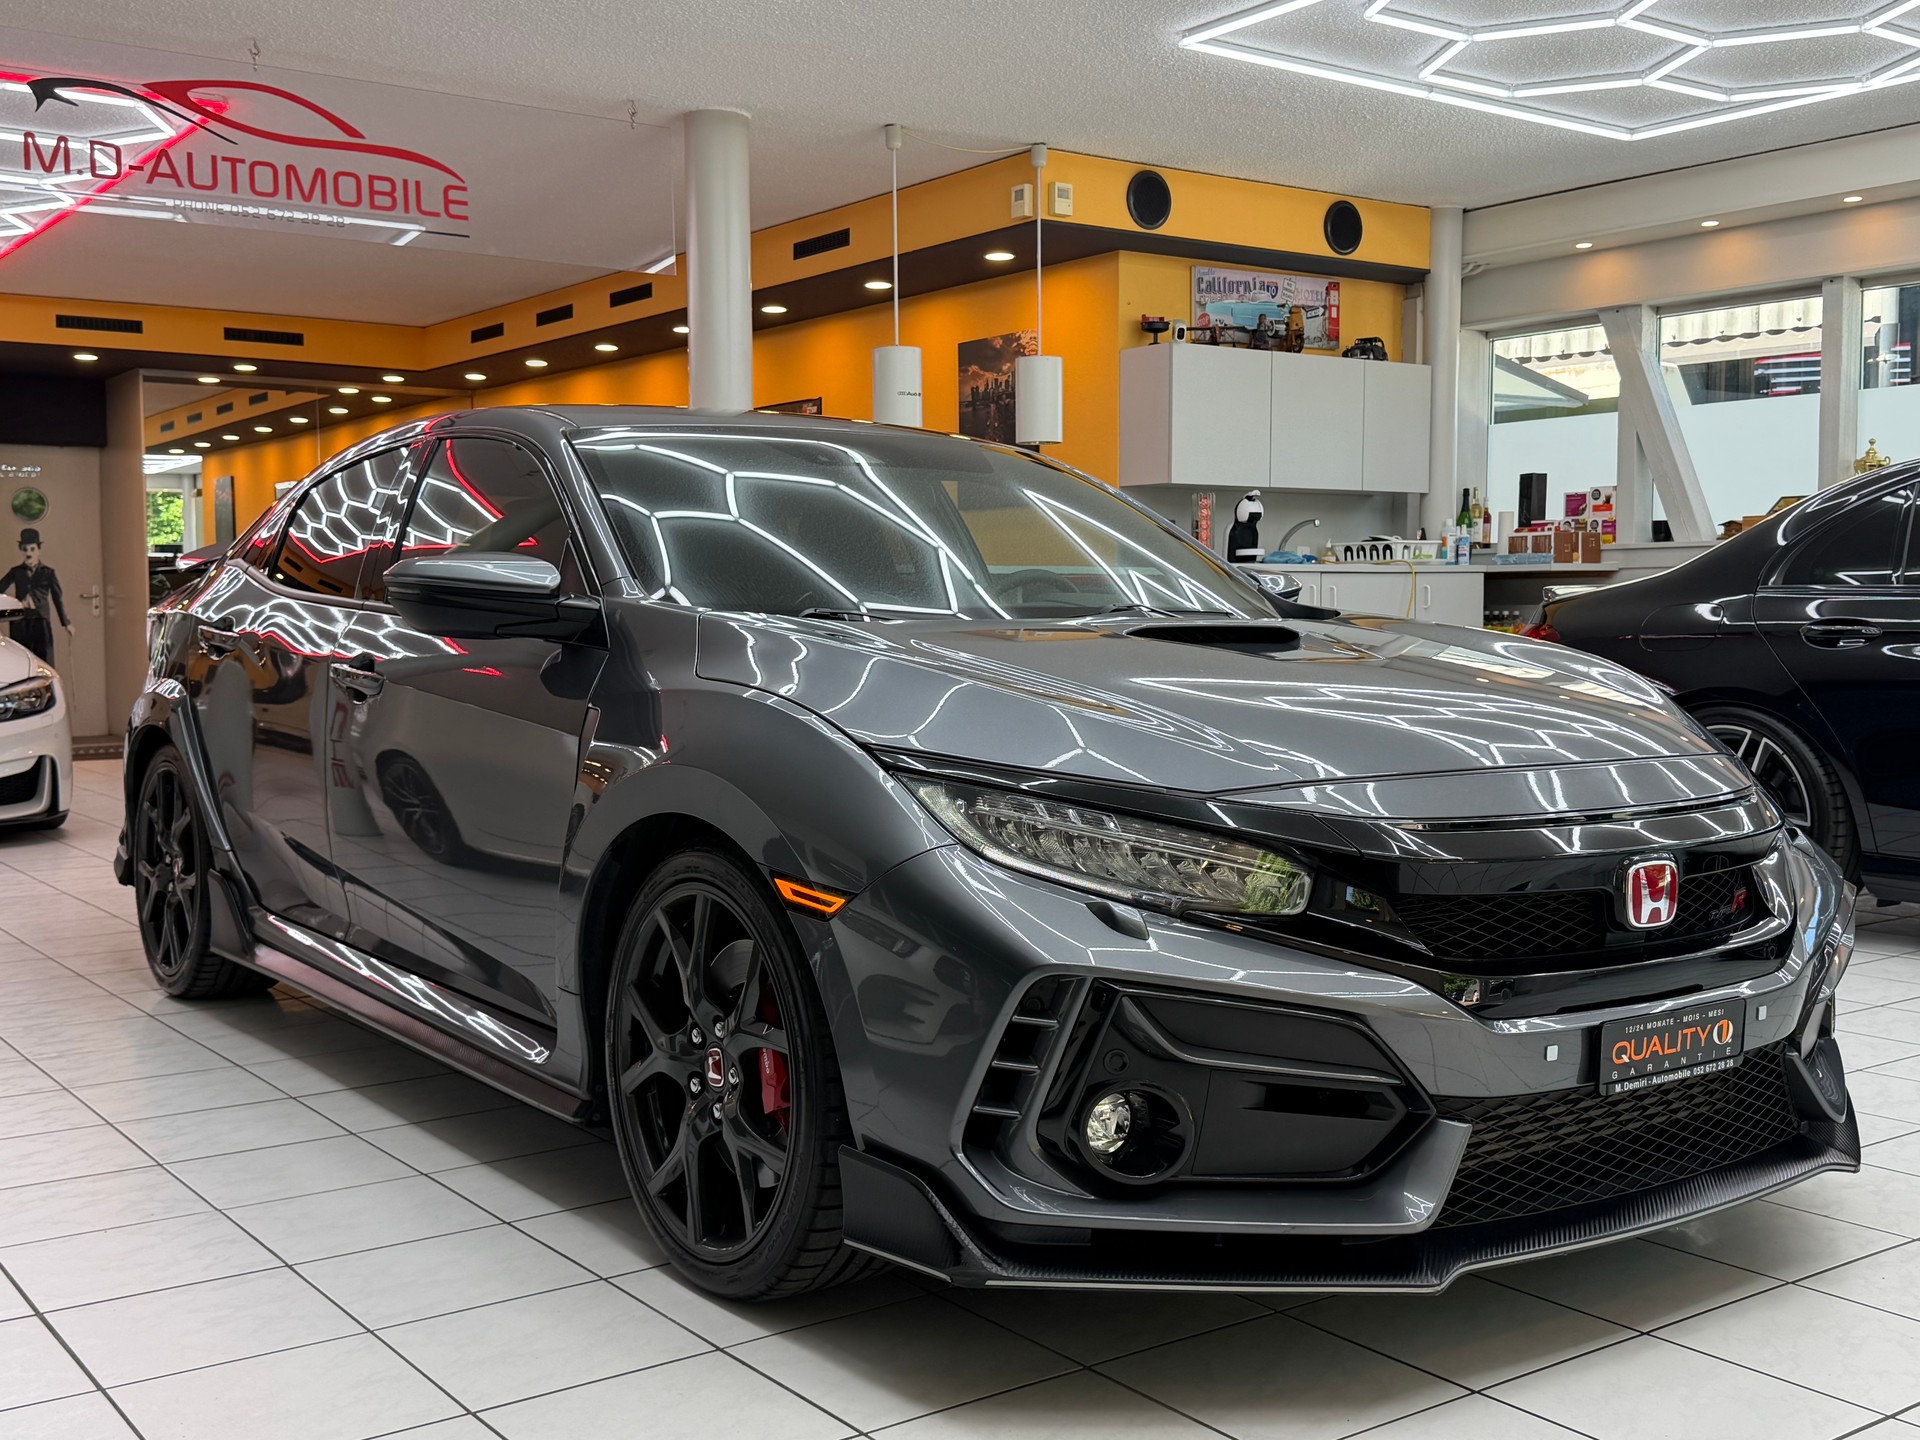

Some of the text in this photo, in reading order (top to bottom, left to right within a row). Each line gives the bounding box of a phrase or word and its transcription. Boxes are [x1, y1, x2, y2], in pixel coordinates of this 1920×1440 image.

[23, 131, 469, 222] M.D-AUTOMOBILE
[173, 199, 225, 215] PHONE
[1197, 276, 1266, 295] California
[1268, 286, 1276, 296] 10
[1731, 886, 1747, 913] R
[1625, 1024, 1644, 1034] 12/24
[1646, 1019, 1674, 1030] MONATE
[1683, 1013, 1700, 1023] MOIS
[1708, 1008, 1724, 1018] MESI
[1612, 1024, 1712, 1065] QUALITY
[1611, 1047, 1731, 1080] GARANTIE
[1652, 1069, 1691, 1085] Automobile
[1693, 1066, 1704, 1076] 052
[1705, 1063, 1716, 1073] 672
[1717, 1061, 1725, 1071] 28
[1726, 1059, 1734, 1069] 28
